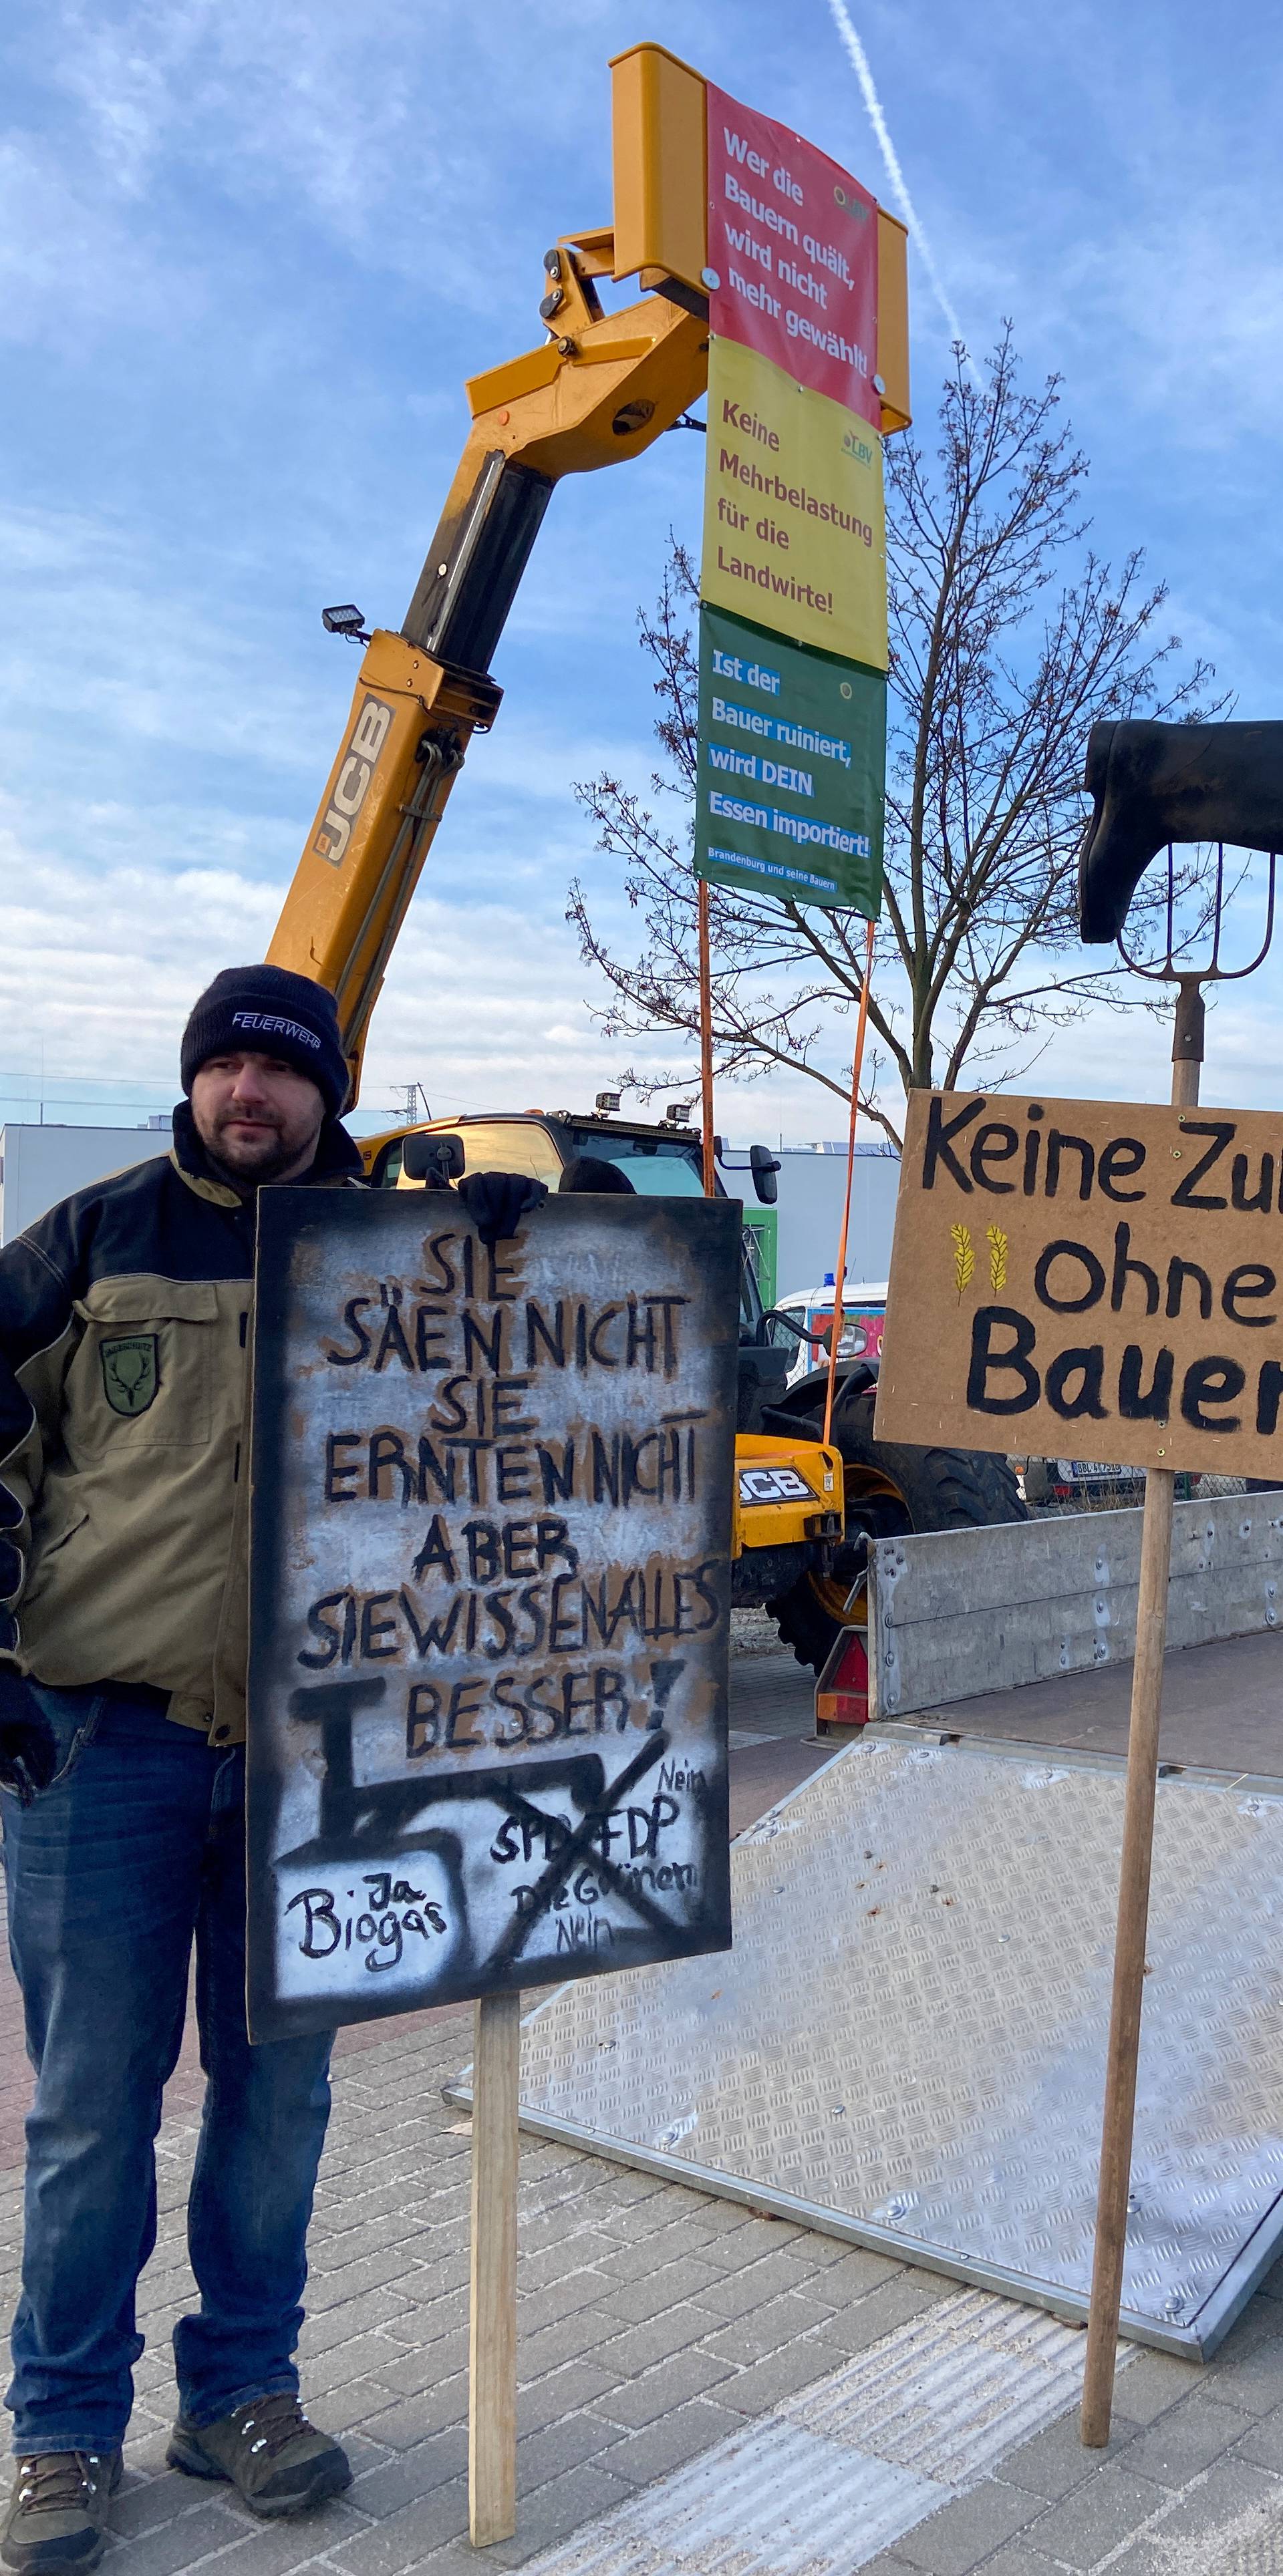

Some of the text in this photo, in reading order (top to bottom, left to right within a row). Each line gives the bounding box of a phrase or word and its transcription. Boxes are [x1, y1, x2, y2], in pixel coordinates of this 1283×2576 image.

[724, 128, 803, 206] Wer die
[724, 172, 799, 245] Bauern
[803, 234, 855, 290] quält,
[724, 222, 827, 309] wird nicht
[728, 267, 868, 378] mehr gewählt!
[722, 399, 780, 452] Keine
[718, 498, 790, 550] für die
[719, 448, 873, 548] Mehrbelastung
[718, 545, 833, 615] Landwirte!
[713, 649, 780, 693] Ist der
[712, 697, 851, 768] Bauer ruiniert,
[325, 701, 390, 862] JCB
[710, 748, 813, 796] wird DEIN
[710, 791, 869, 857] Essen importiert!
[708, 846, 835, 891] Brandenburg und seine Bauern
[232, 1012, 321, 1050] FEUERWEHR
[923, 1096, 1283, 1215] Keine Zu
[420, 1233, 519, 1301] SIE
[327, 1283, 691, 1382] SÄEN NICHT
[431, 1375, 535, 1436] SIE
[325, 1410, 710, 1510] ERNTEN NICHT
[414, 1514, 579, 1586] ABER
[658, 1758, 706, 1793] Nein
[597, 1792, 680, 1859] FDP
[363, 1873, 426, 1913] Ja
[284, 1888, 448, 1973] Biogas
[555, 1906, 615, 1953] Nein
